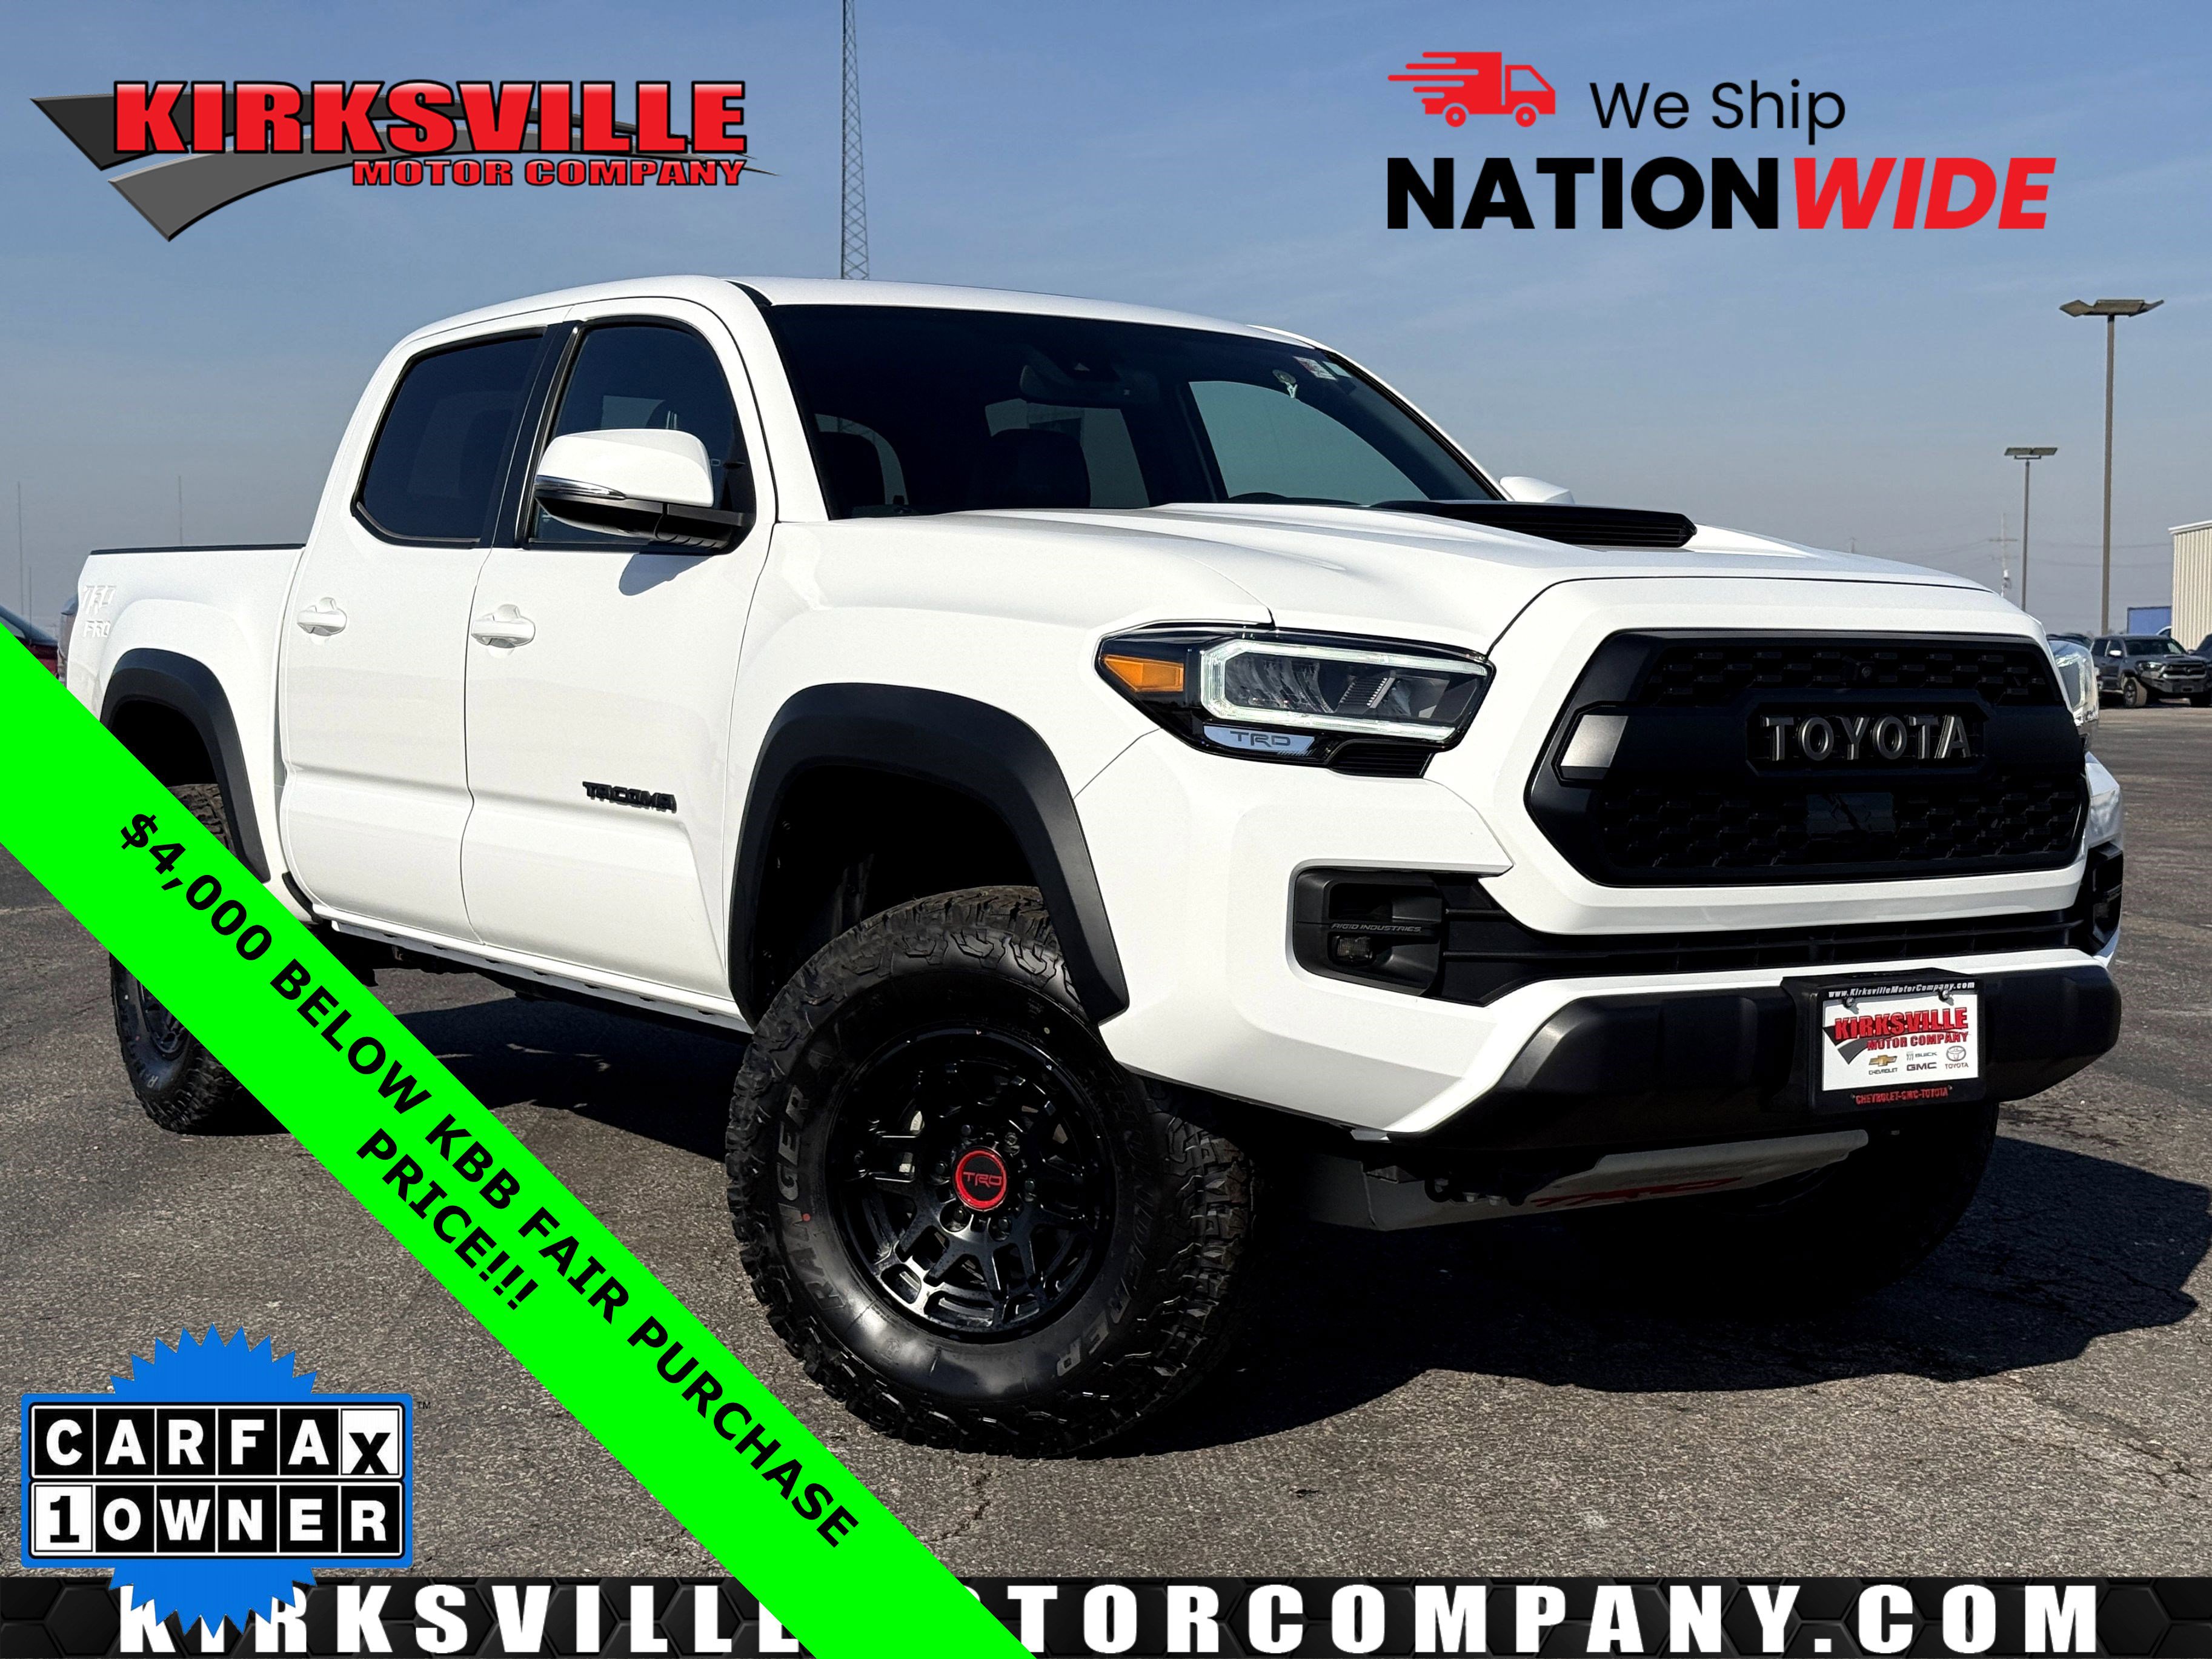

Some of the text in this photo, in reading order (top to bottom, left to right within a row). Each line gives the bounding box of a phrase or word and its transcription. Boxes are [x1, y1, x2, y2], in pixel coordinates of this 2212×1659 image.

[1230, 731, 1291, 747] TRD
[1760, 714, 1973, 762] TOYOTA
[582, 781, 677, 814] TACOMA
[1359, 924, 1422, 933] INDUSTRIES
[1828, 981, 1975, 999] www.KirksvilleMotorCompany.com
[1834, 1007, 1968, 1040] KIRKSVILLE
[1867, 1032, 1969, 1051] MOTOR COMPANY
[1907, 1062, 1938, 1071] GMC
[963, 1171, 1002, 1188] TRD
[777, 1085, 846, 1309] RANGER
